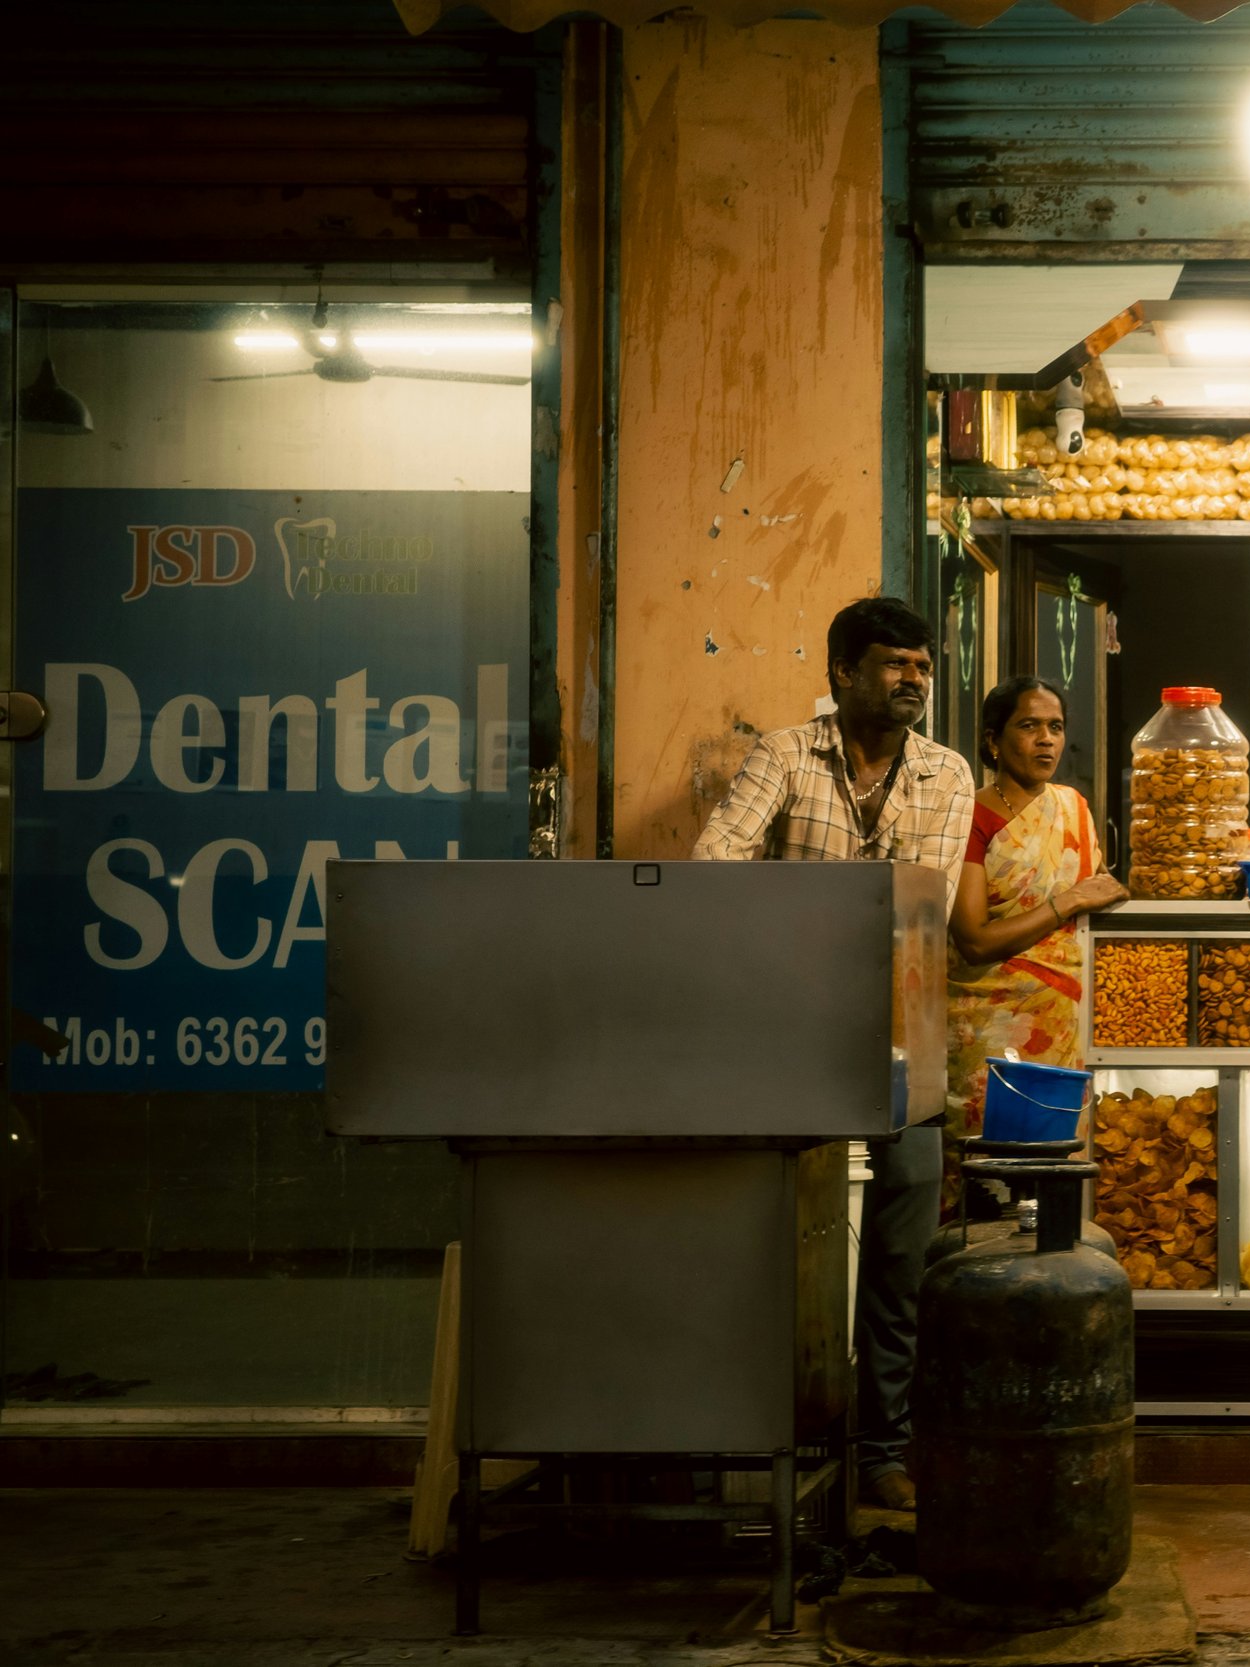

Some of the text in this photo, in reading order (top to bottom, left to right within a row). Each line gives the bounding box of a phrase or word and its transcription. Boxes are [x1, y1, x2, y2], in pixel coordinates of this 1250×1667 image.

[121, 525, 256, 602] JSD
[293, 527, 433, 562] Techno
[306, 566, 418, 595] Dental
[43, 662, 509, 793] Dental
[42, 1016, 156, 1066] Mob:
[176, 1016, 287, 1066] 6362
